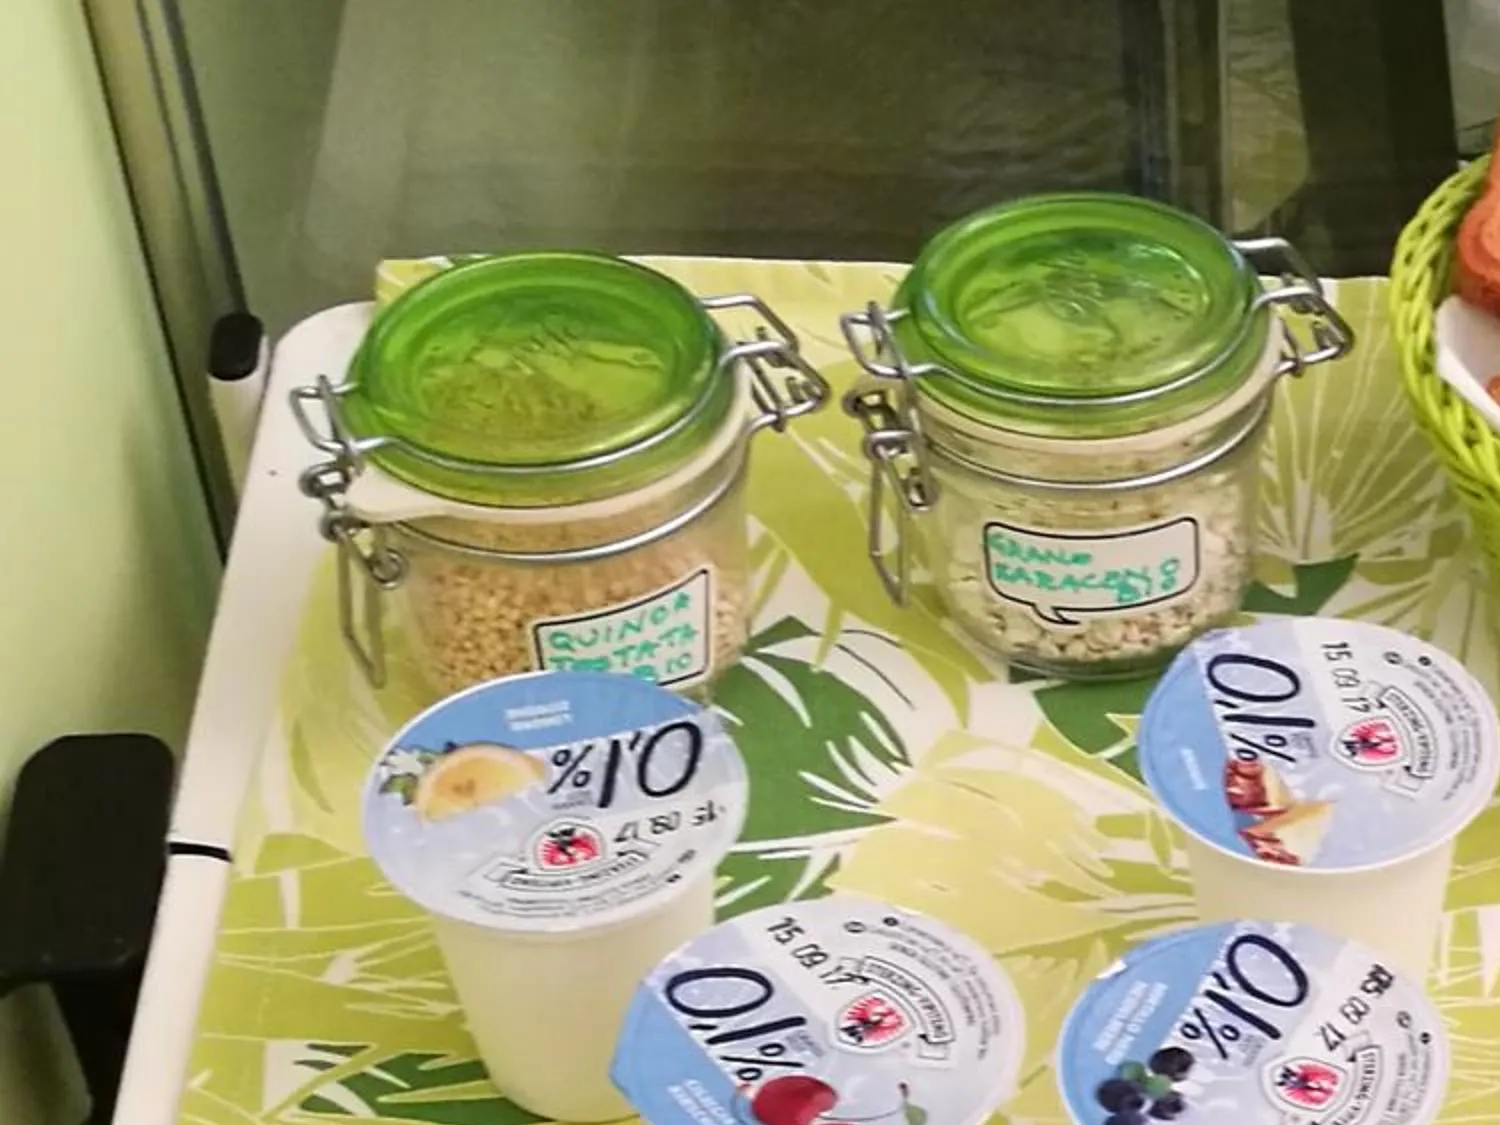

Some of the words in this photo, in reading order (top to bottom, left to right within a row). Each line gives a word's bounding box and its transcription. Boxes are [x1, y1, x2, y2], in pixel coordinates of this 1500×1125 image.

[549, 591, 691, 651] QUINOA
[1321, 640, 1354, 662] 15
[1206, 653, 1316, 763] 0,1%
[547, 721, 703, 809] 0,1%
[766, 917, 806, 947] 15
[790, 941, 831, 969] 09
[664, 965, 808, 1084] 0,1%
[1179, 932, 1310, 1060] 0,1%
[1317, 1020, 1348, 1053] 17
